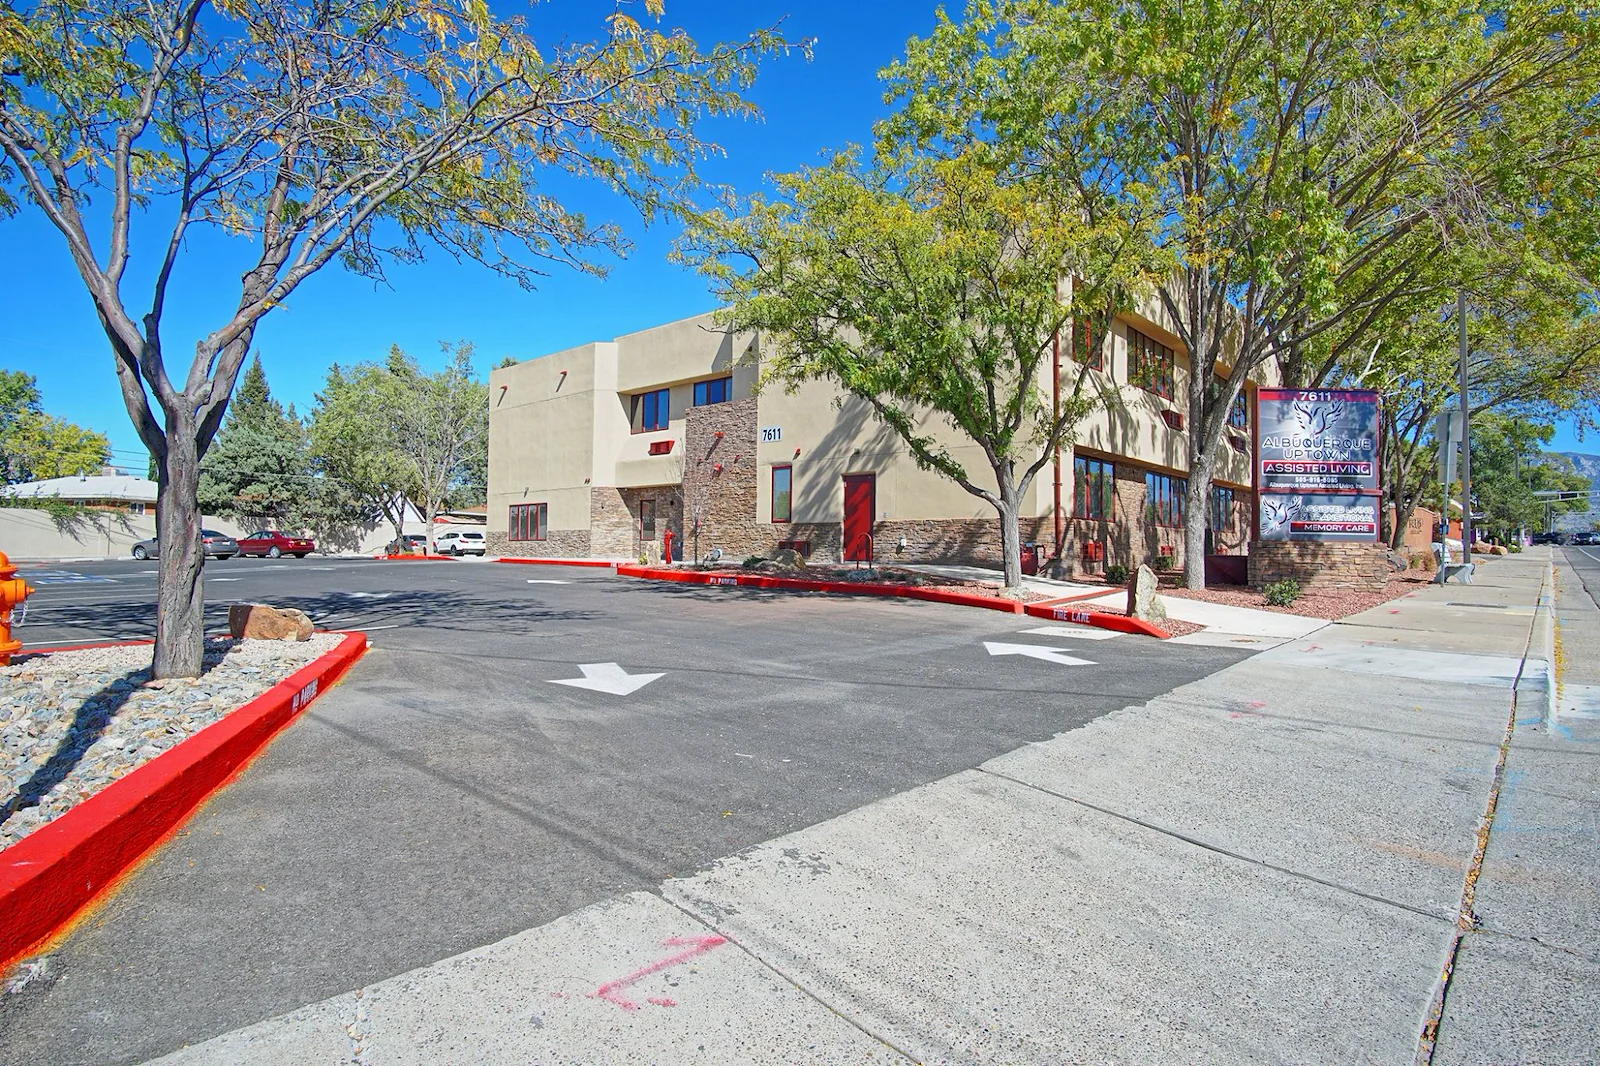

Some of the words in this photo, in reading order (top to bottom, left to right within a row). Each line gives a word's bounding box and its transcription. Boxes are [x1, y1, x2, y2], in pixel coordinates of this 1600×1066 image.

[1299, 391, 1331, 401] 7611
[763, 427, 781, 441] 7611
[1262, 436, 1371, 450] ALBUQUERQUE
[1283, 449, 1350, 460] UPTOWN
[1265, 463, 1327, 473] ASSISTED
[1331, 464, 1369, 474] LIVING
[1301, 505, 1345, 513] ASSISTED
[1345, 505, 1374, 514] LIVING
[1053, 609, 1068, 620] FIRE
[1071, 611, 1090, 623] LANE
